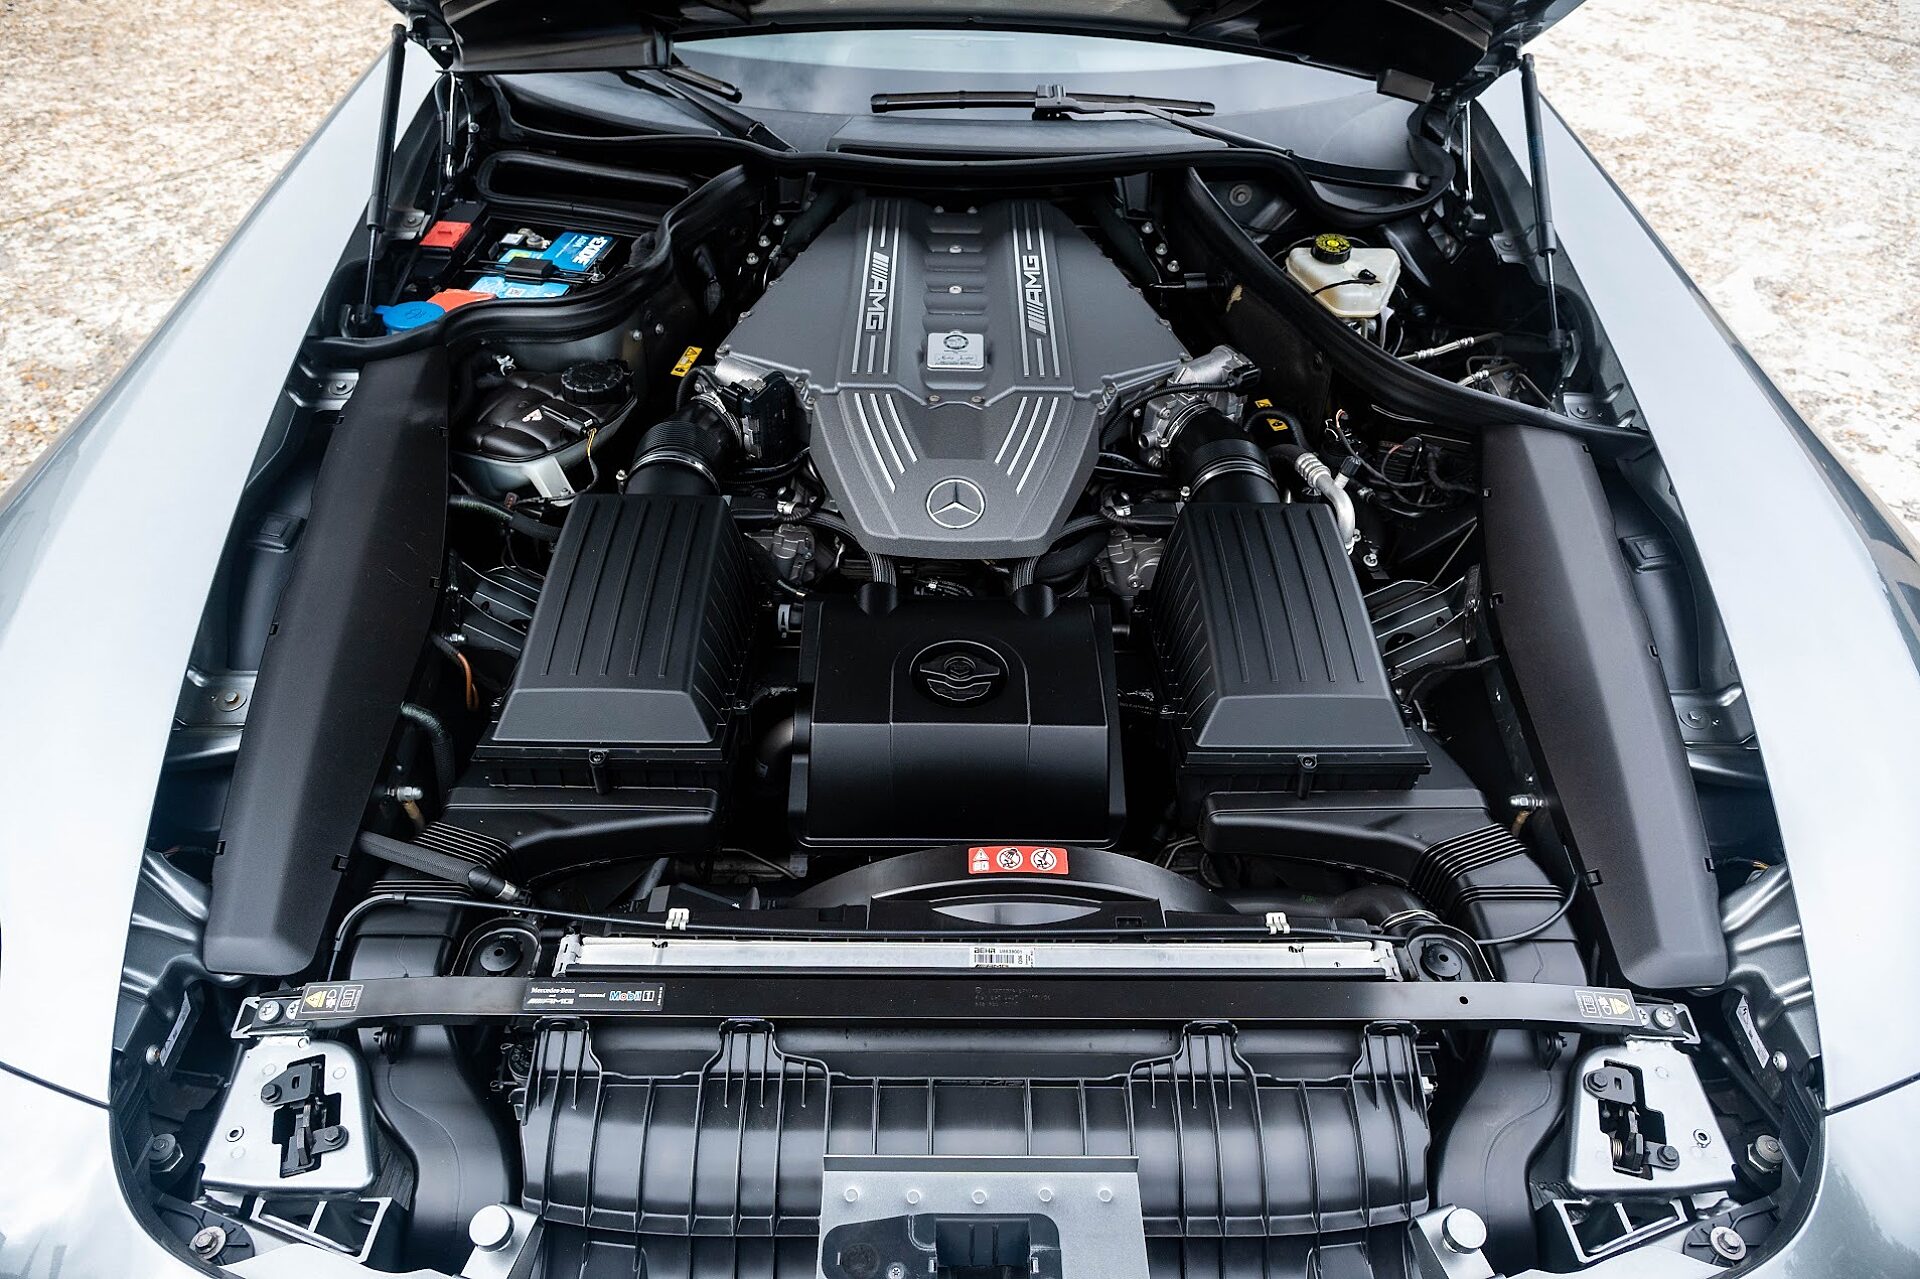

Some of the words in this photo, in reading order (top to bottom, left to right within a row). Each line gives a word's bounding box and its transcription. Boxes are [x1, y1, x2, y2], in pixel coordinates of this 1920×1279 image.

[572, 236, 608, 265] EXIDE
[1022, 255, 1044, 308] AMG
[866, 275, 888, 330] AMG
[609, 990, 642, 1001] Mobil
[643, 990, 655, 1002] 1
